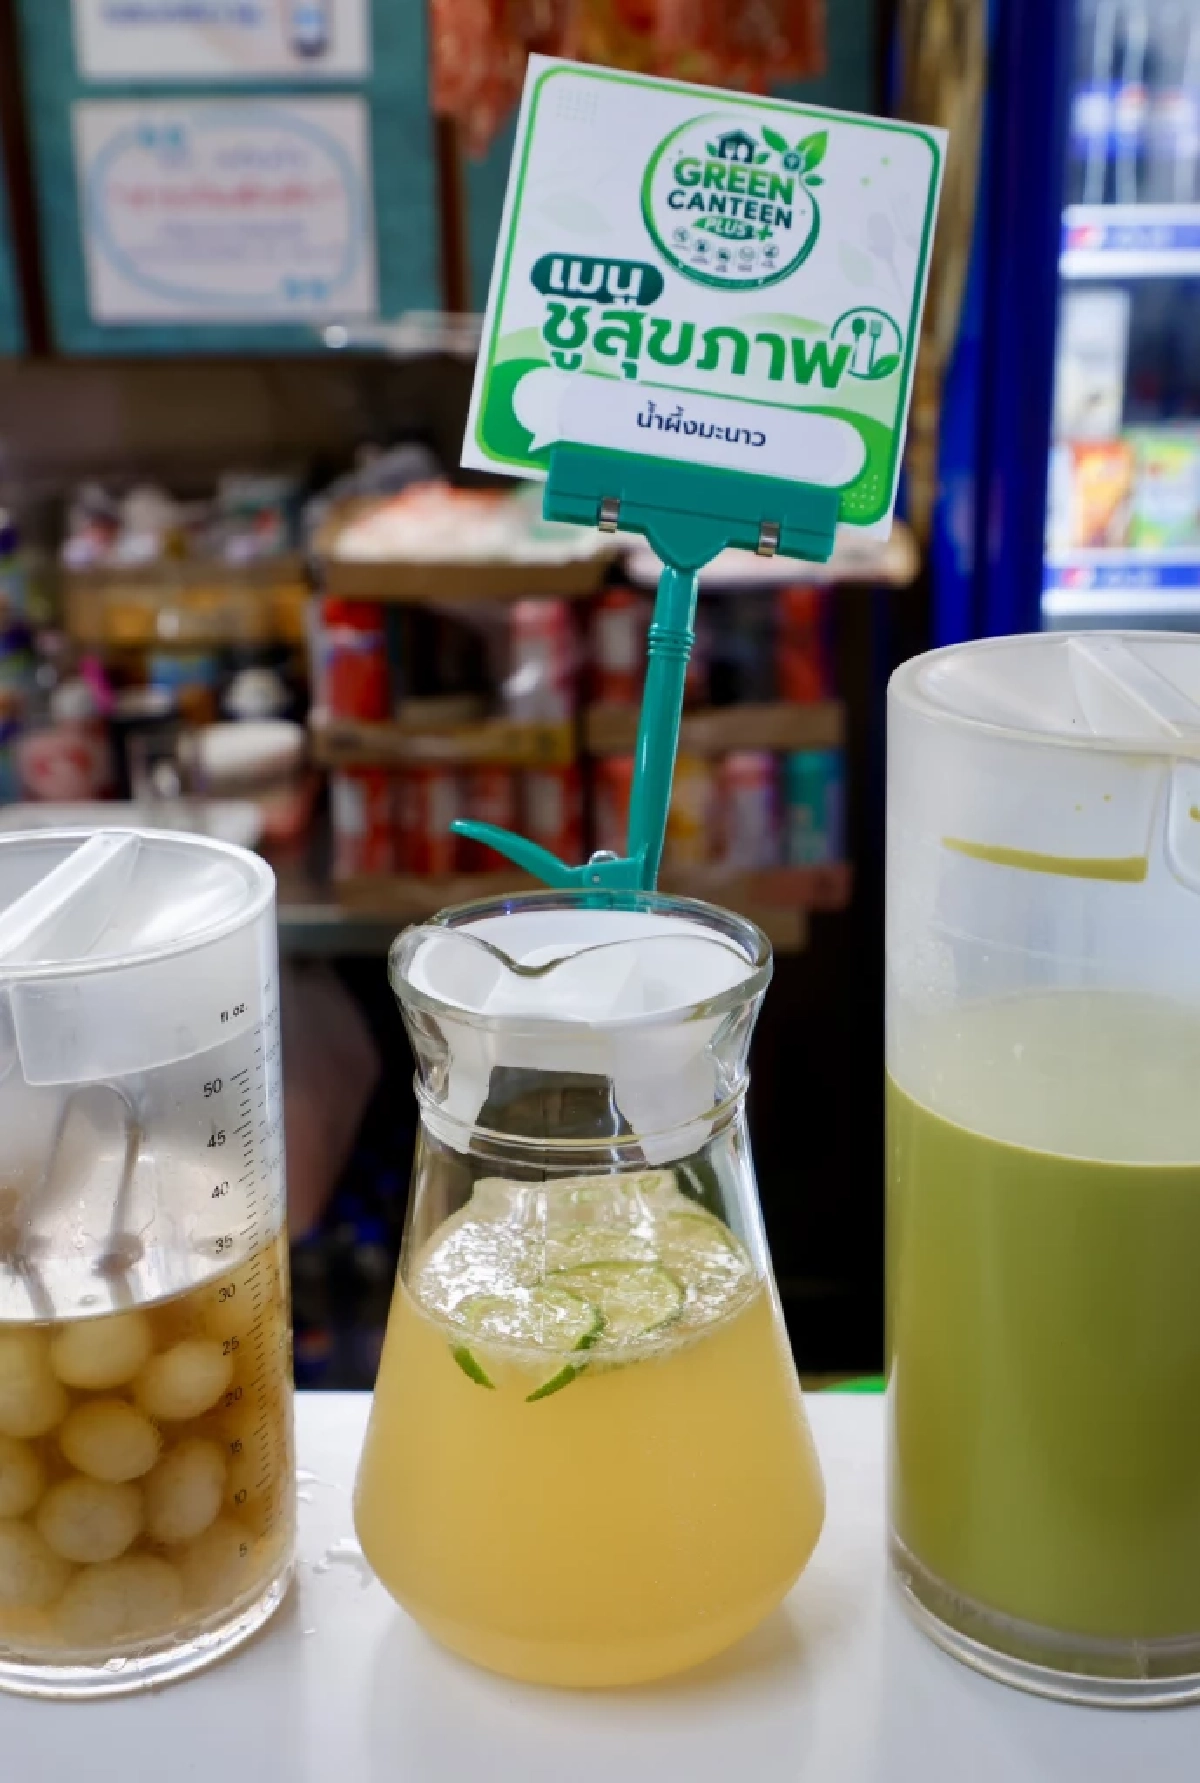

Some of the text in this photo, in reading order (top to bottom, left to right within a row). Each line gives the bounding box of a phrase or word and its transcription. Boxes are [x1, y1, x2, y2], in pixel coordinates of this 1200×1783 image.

[673, 156, 795, 206] GREEN
[667, 189, 793, 230] CANTEEN
[703, 217, 749, 239] PLUS
[549, 258, 644, 305] เมนู
[542, 301, 852, 388] ชูสุขภาพ
[636, 399, 767, 447] น้ำผึ้งมะนาว
[203, 1078, 222, 1098] 50
[207, 1130, 226, 1148] 45
[211, 1181, 229, 1199] 40
[215, 1234, 233, 1254] 35
[218, 1283, 236, 1303] 30
[222, 1336, 240, 1356] 25
[225, 1386, 243, 1407] 20
[230, 1438, 243, 1454] 15
[234, 1488, 248, 1505] 10
